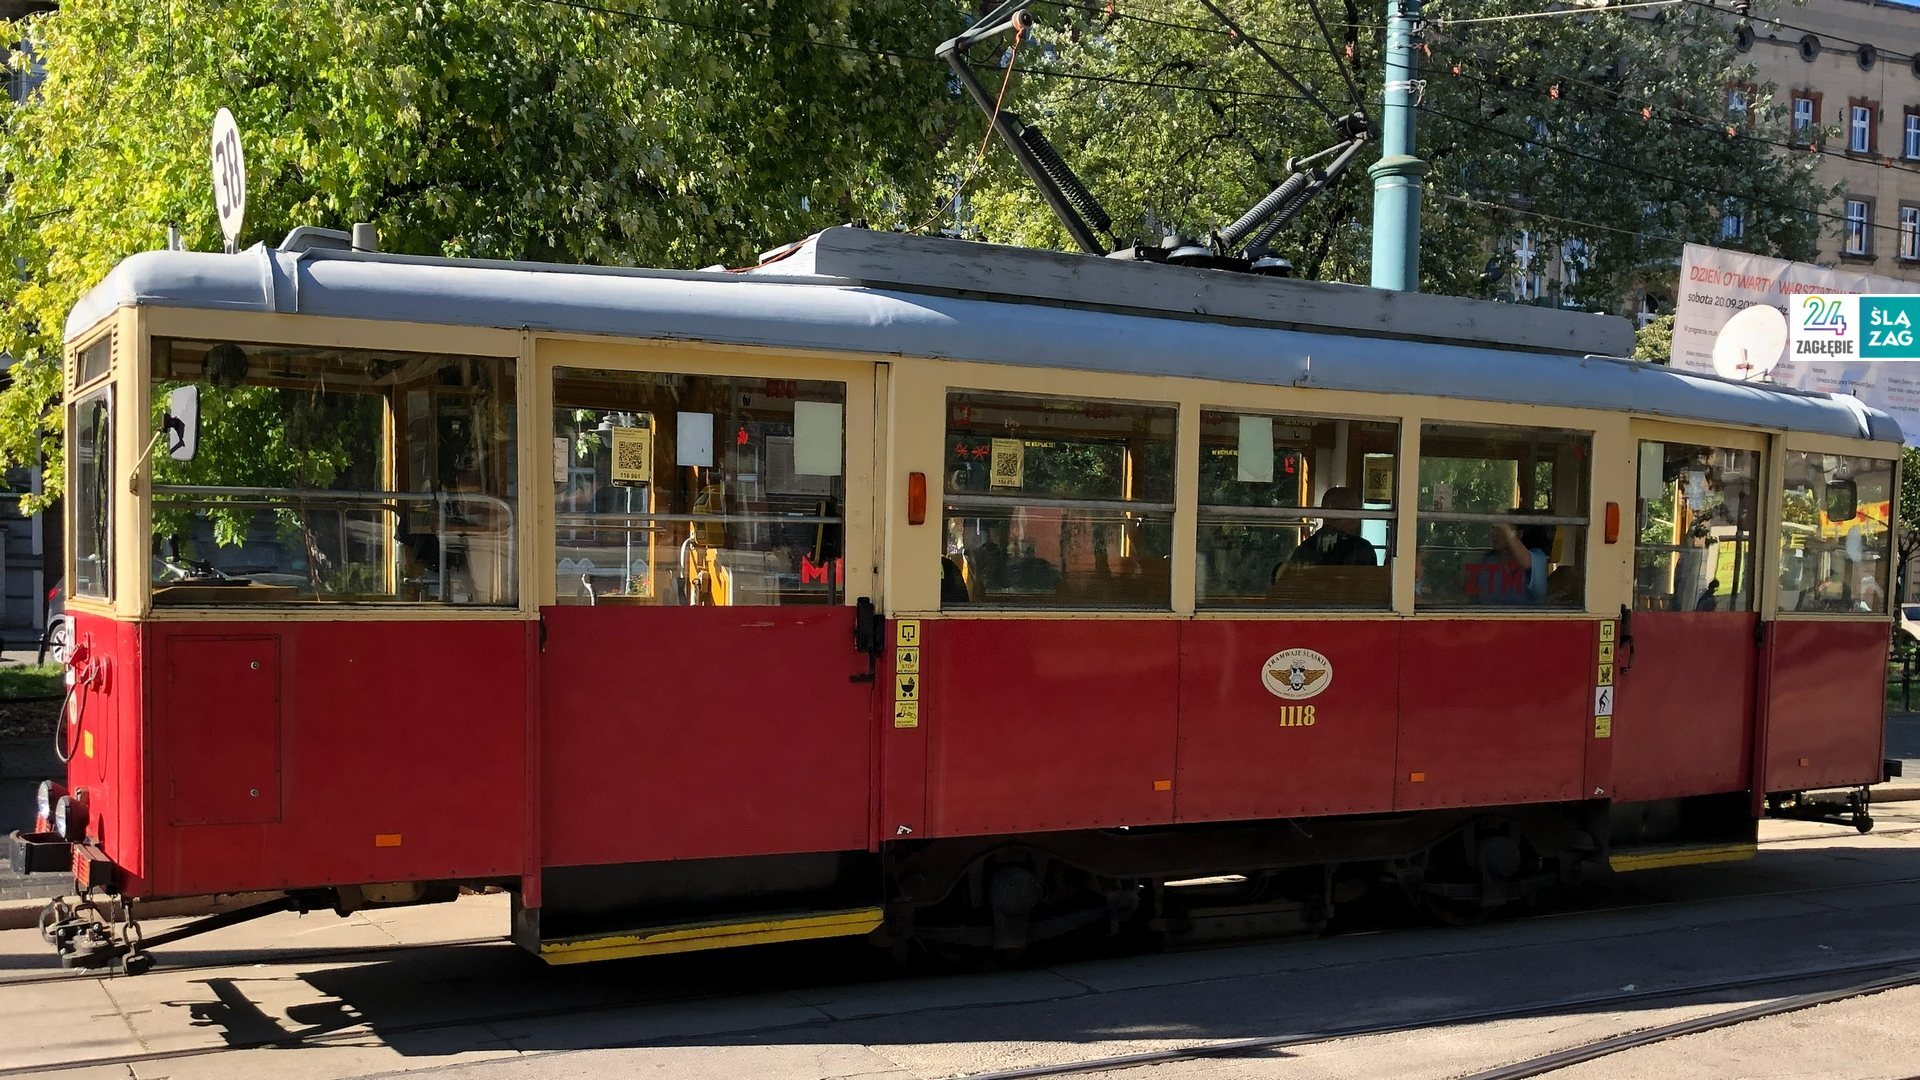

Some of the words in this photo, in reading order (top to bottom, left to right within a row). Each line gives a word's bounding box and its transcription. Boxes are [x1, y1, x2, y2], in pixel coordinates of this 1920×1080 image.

[215, 128, 242, 219] 38
[1690, 266, 1721, 284] DZIEŃ
[1723, 272, 1775, 292] OTWARTY
[1688, 292, 1713, 305] sobota
[1714, 296, 1758, 310] 20.09.20
[1465, 562, 1524, 593] ZTM
[1267, 650, 1301, 668] TRAMWAJE
[1279, 704, 1316, 727] 1118
